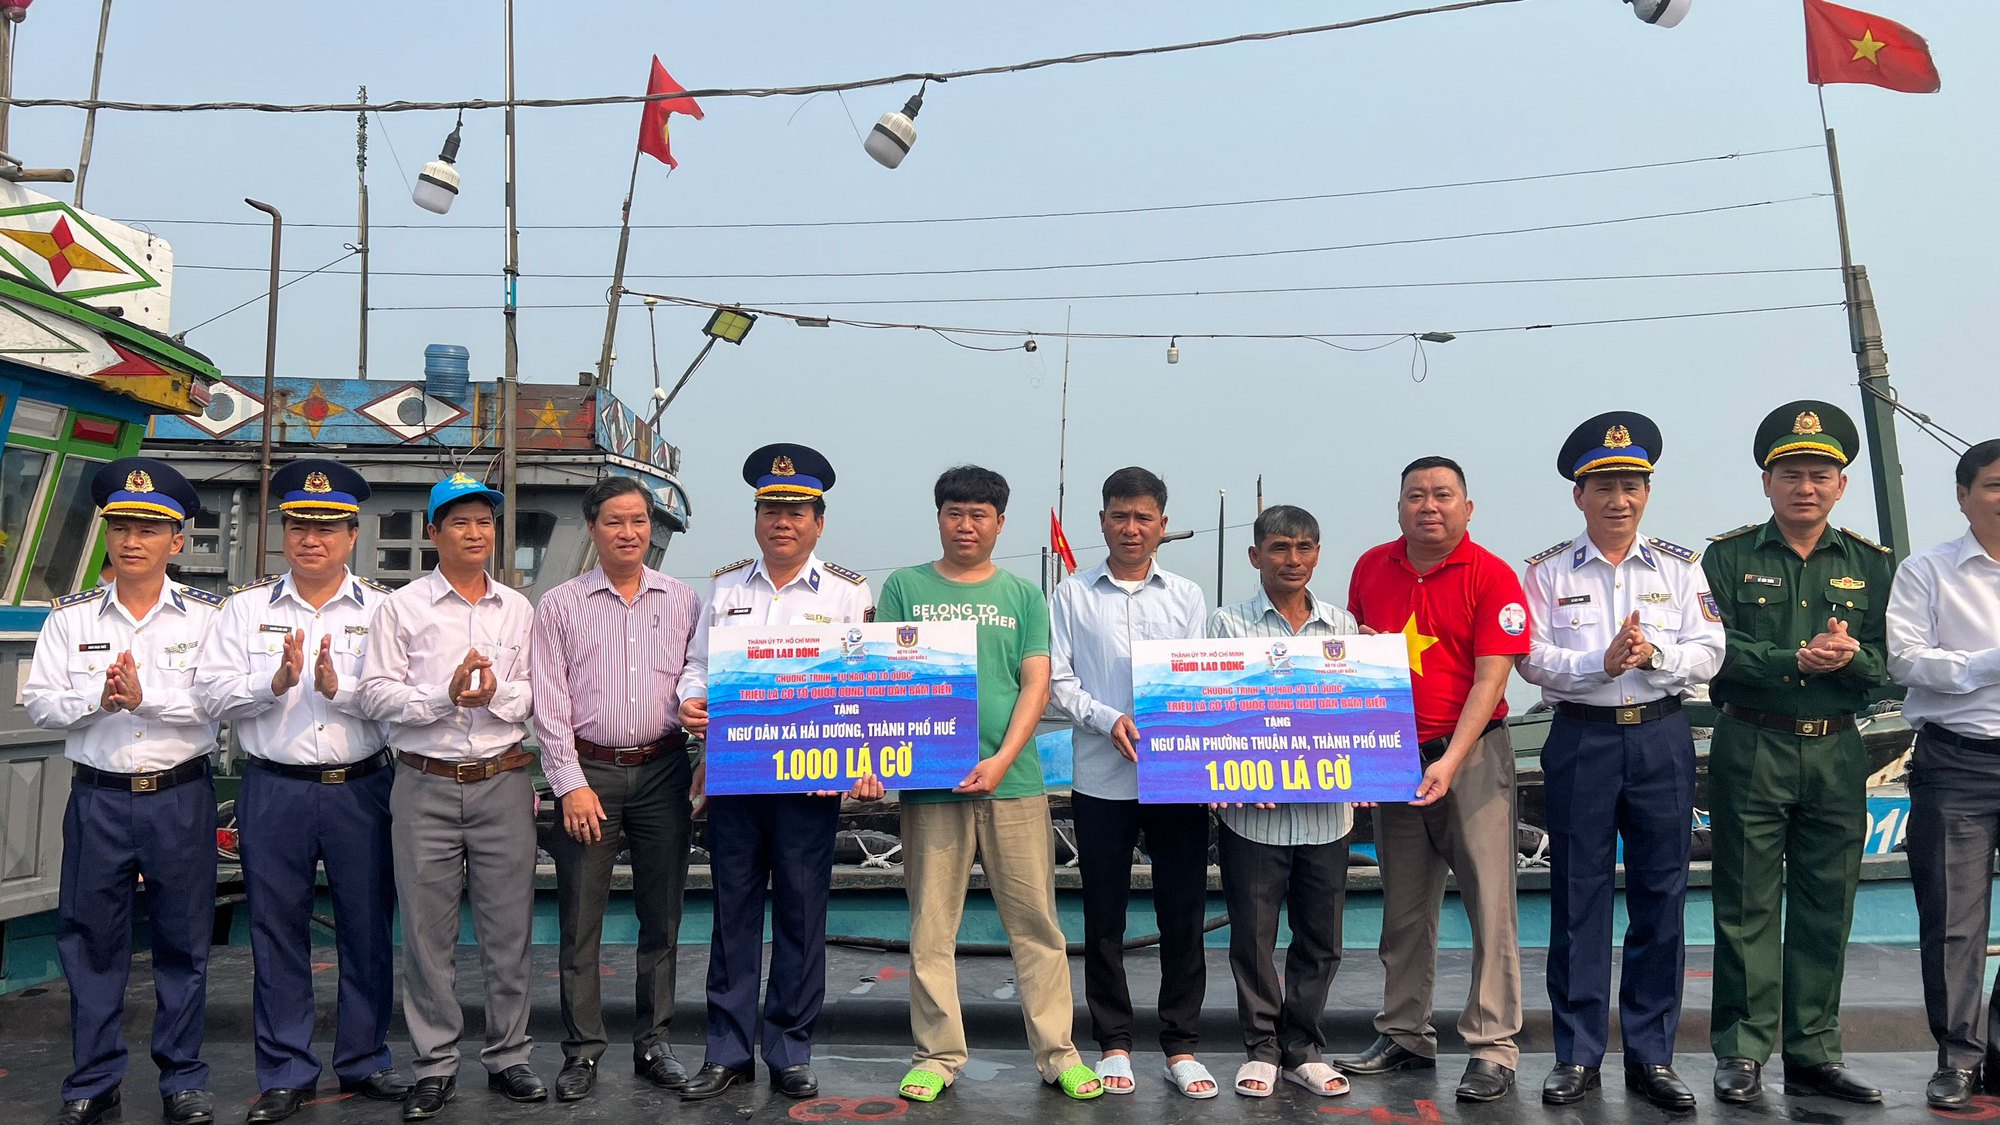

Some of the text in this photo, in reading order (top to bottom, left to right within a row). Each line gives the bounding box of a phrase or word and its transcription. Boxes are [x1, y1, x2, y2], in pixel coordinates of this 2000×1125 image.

[912, 603, 998, 617] BELONG TO
[967, 614, 1016, 630] OTHER
[833, 702, 860, 717] TẶNG
[727, 717, 956, 741] NGƯ DÂN XÃ HẢI DƯƠNG, THÀNH PHỐ HUẾ
[1263, 715, 1291, 729] TẶNG
[1150, 730, 1401, 752] NGƯ DÂN PHƯỜNG THUẬN AN, THÀNH PHỐ HUẾ
[772, 740, 913, 780] 1.000 LÁ CỜ
[1205, 753, 1352, 790] 1.000 LÁ CỜ
